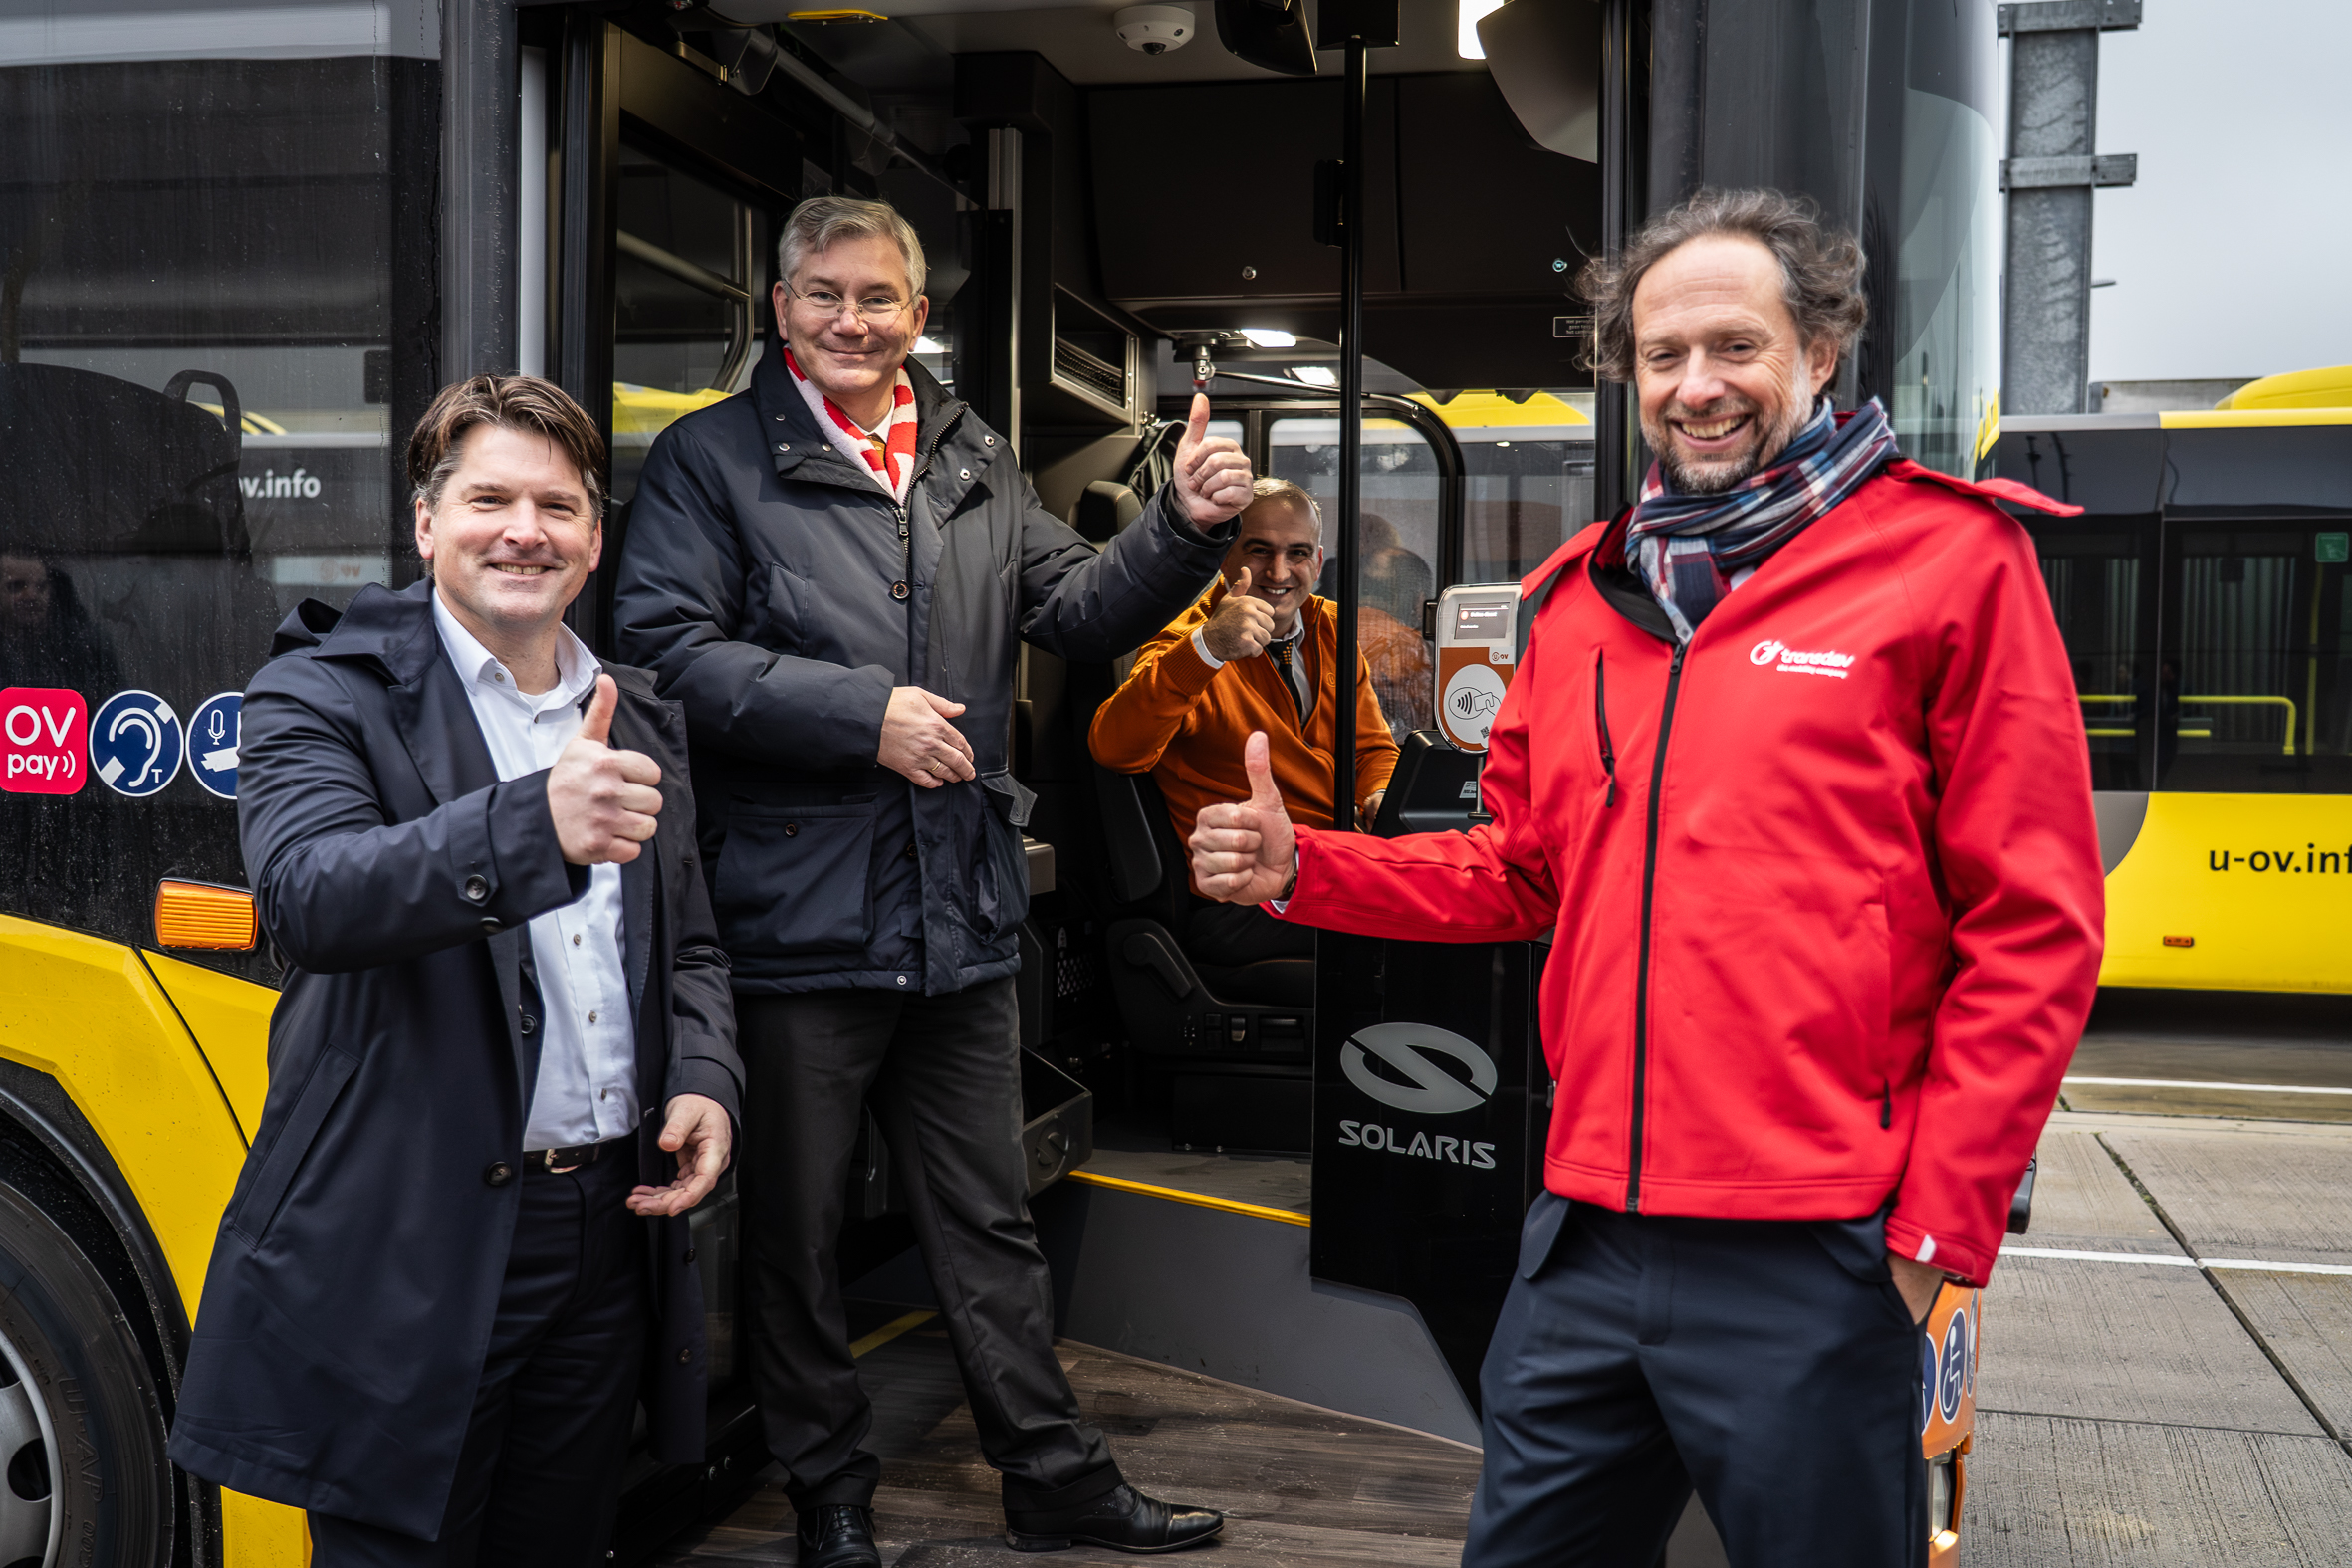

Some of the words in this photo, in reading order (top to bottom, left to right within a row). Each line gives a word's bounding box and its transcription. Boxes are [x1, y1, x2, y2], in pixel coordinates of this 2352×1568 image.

[1780, 648, 1855, 668] transdev
[5, 704, 77, 748] OV
[7, 753, 59, 781] pay
[1338, 1119, 1496, 1170] SOLARIS
